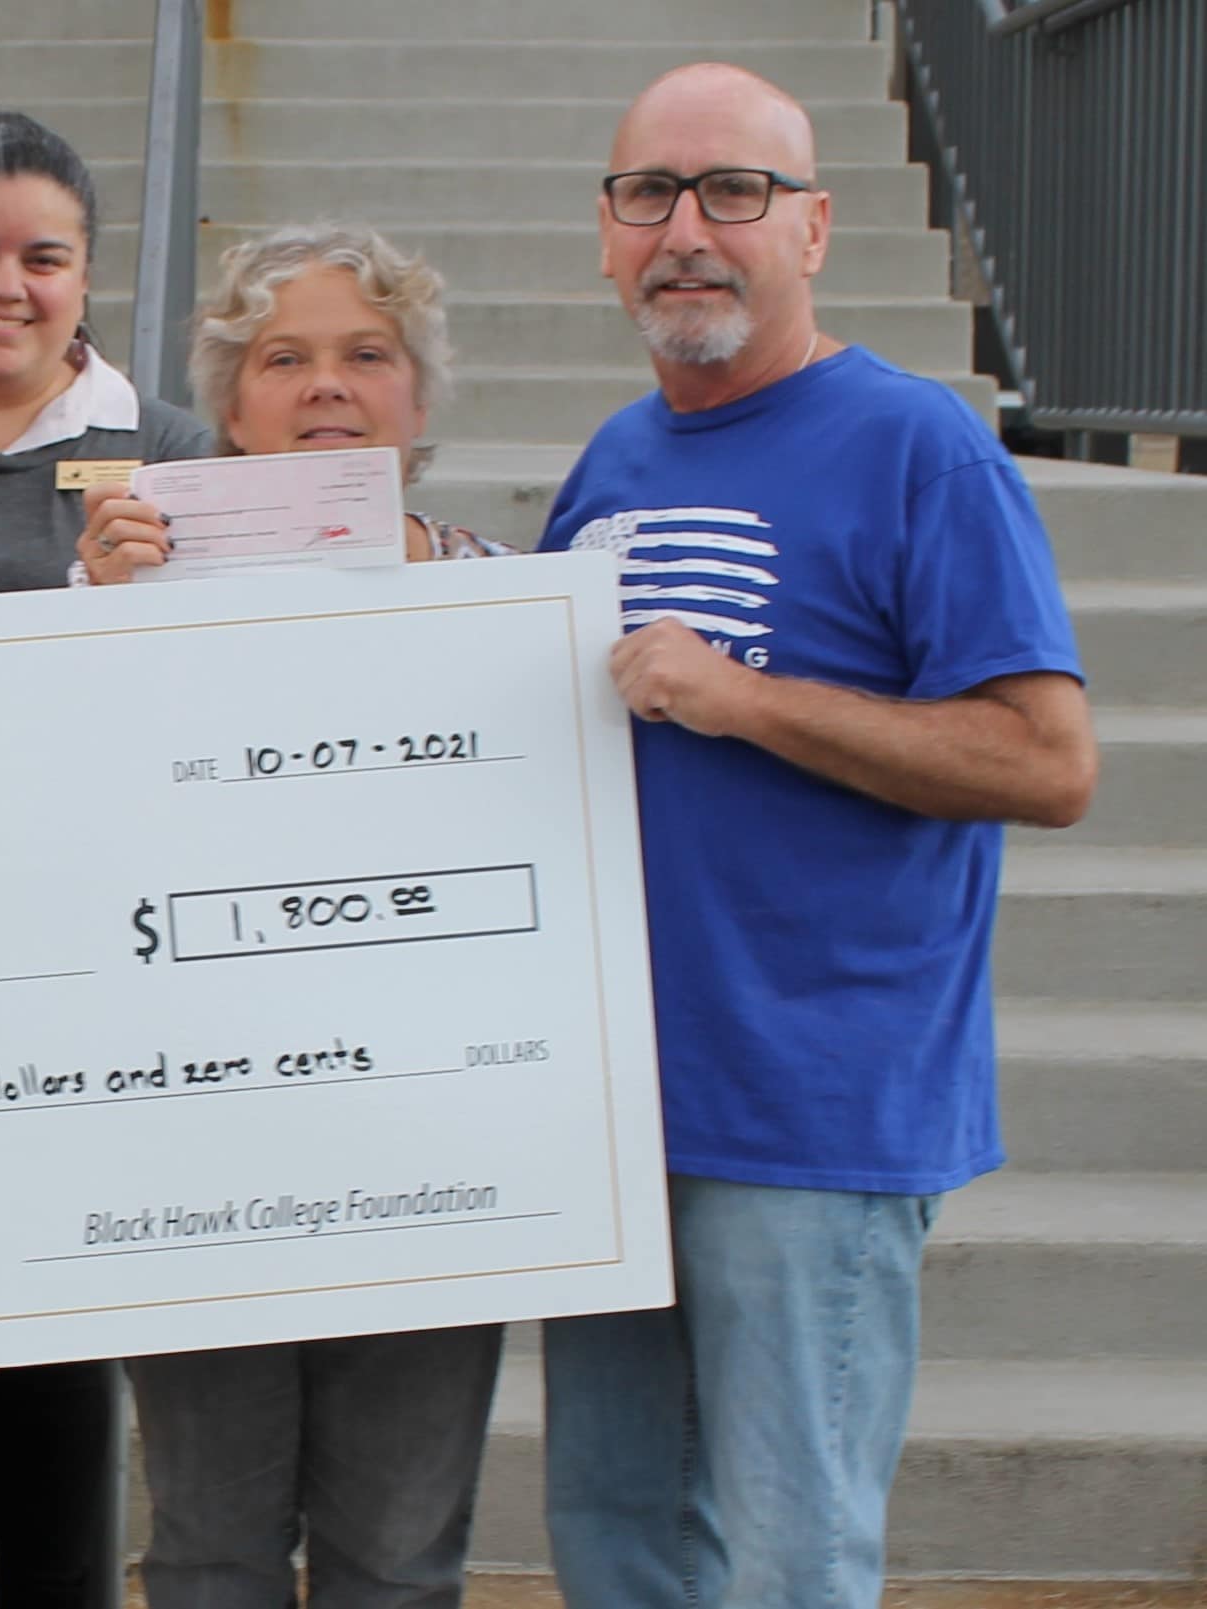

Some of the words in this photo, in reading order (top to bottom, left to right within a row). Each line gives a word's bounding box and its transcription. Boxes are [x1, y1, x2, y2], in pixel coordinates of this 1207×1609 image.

[172, 758, 219, 783] DATE
[244, 731, 481, 777] 10-07-2021
[132, 897, 159, 964] $
[106, 1052, 167, 1094] and
[183, 1058, 253, 1084] zero
[275, 1037, 374, 1078] cents
[465, 1039, 551, 1068] DOLLARS
[83, 1209, 158, 1246] Black
[162, 1200, 240, 1238] Hawk
[244, 1194, 342, 1235] College
[344, 1180, 497, 1222] Foundation
